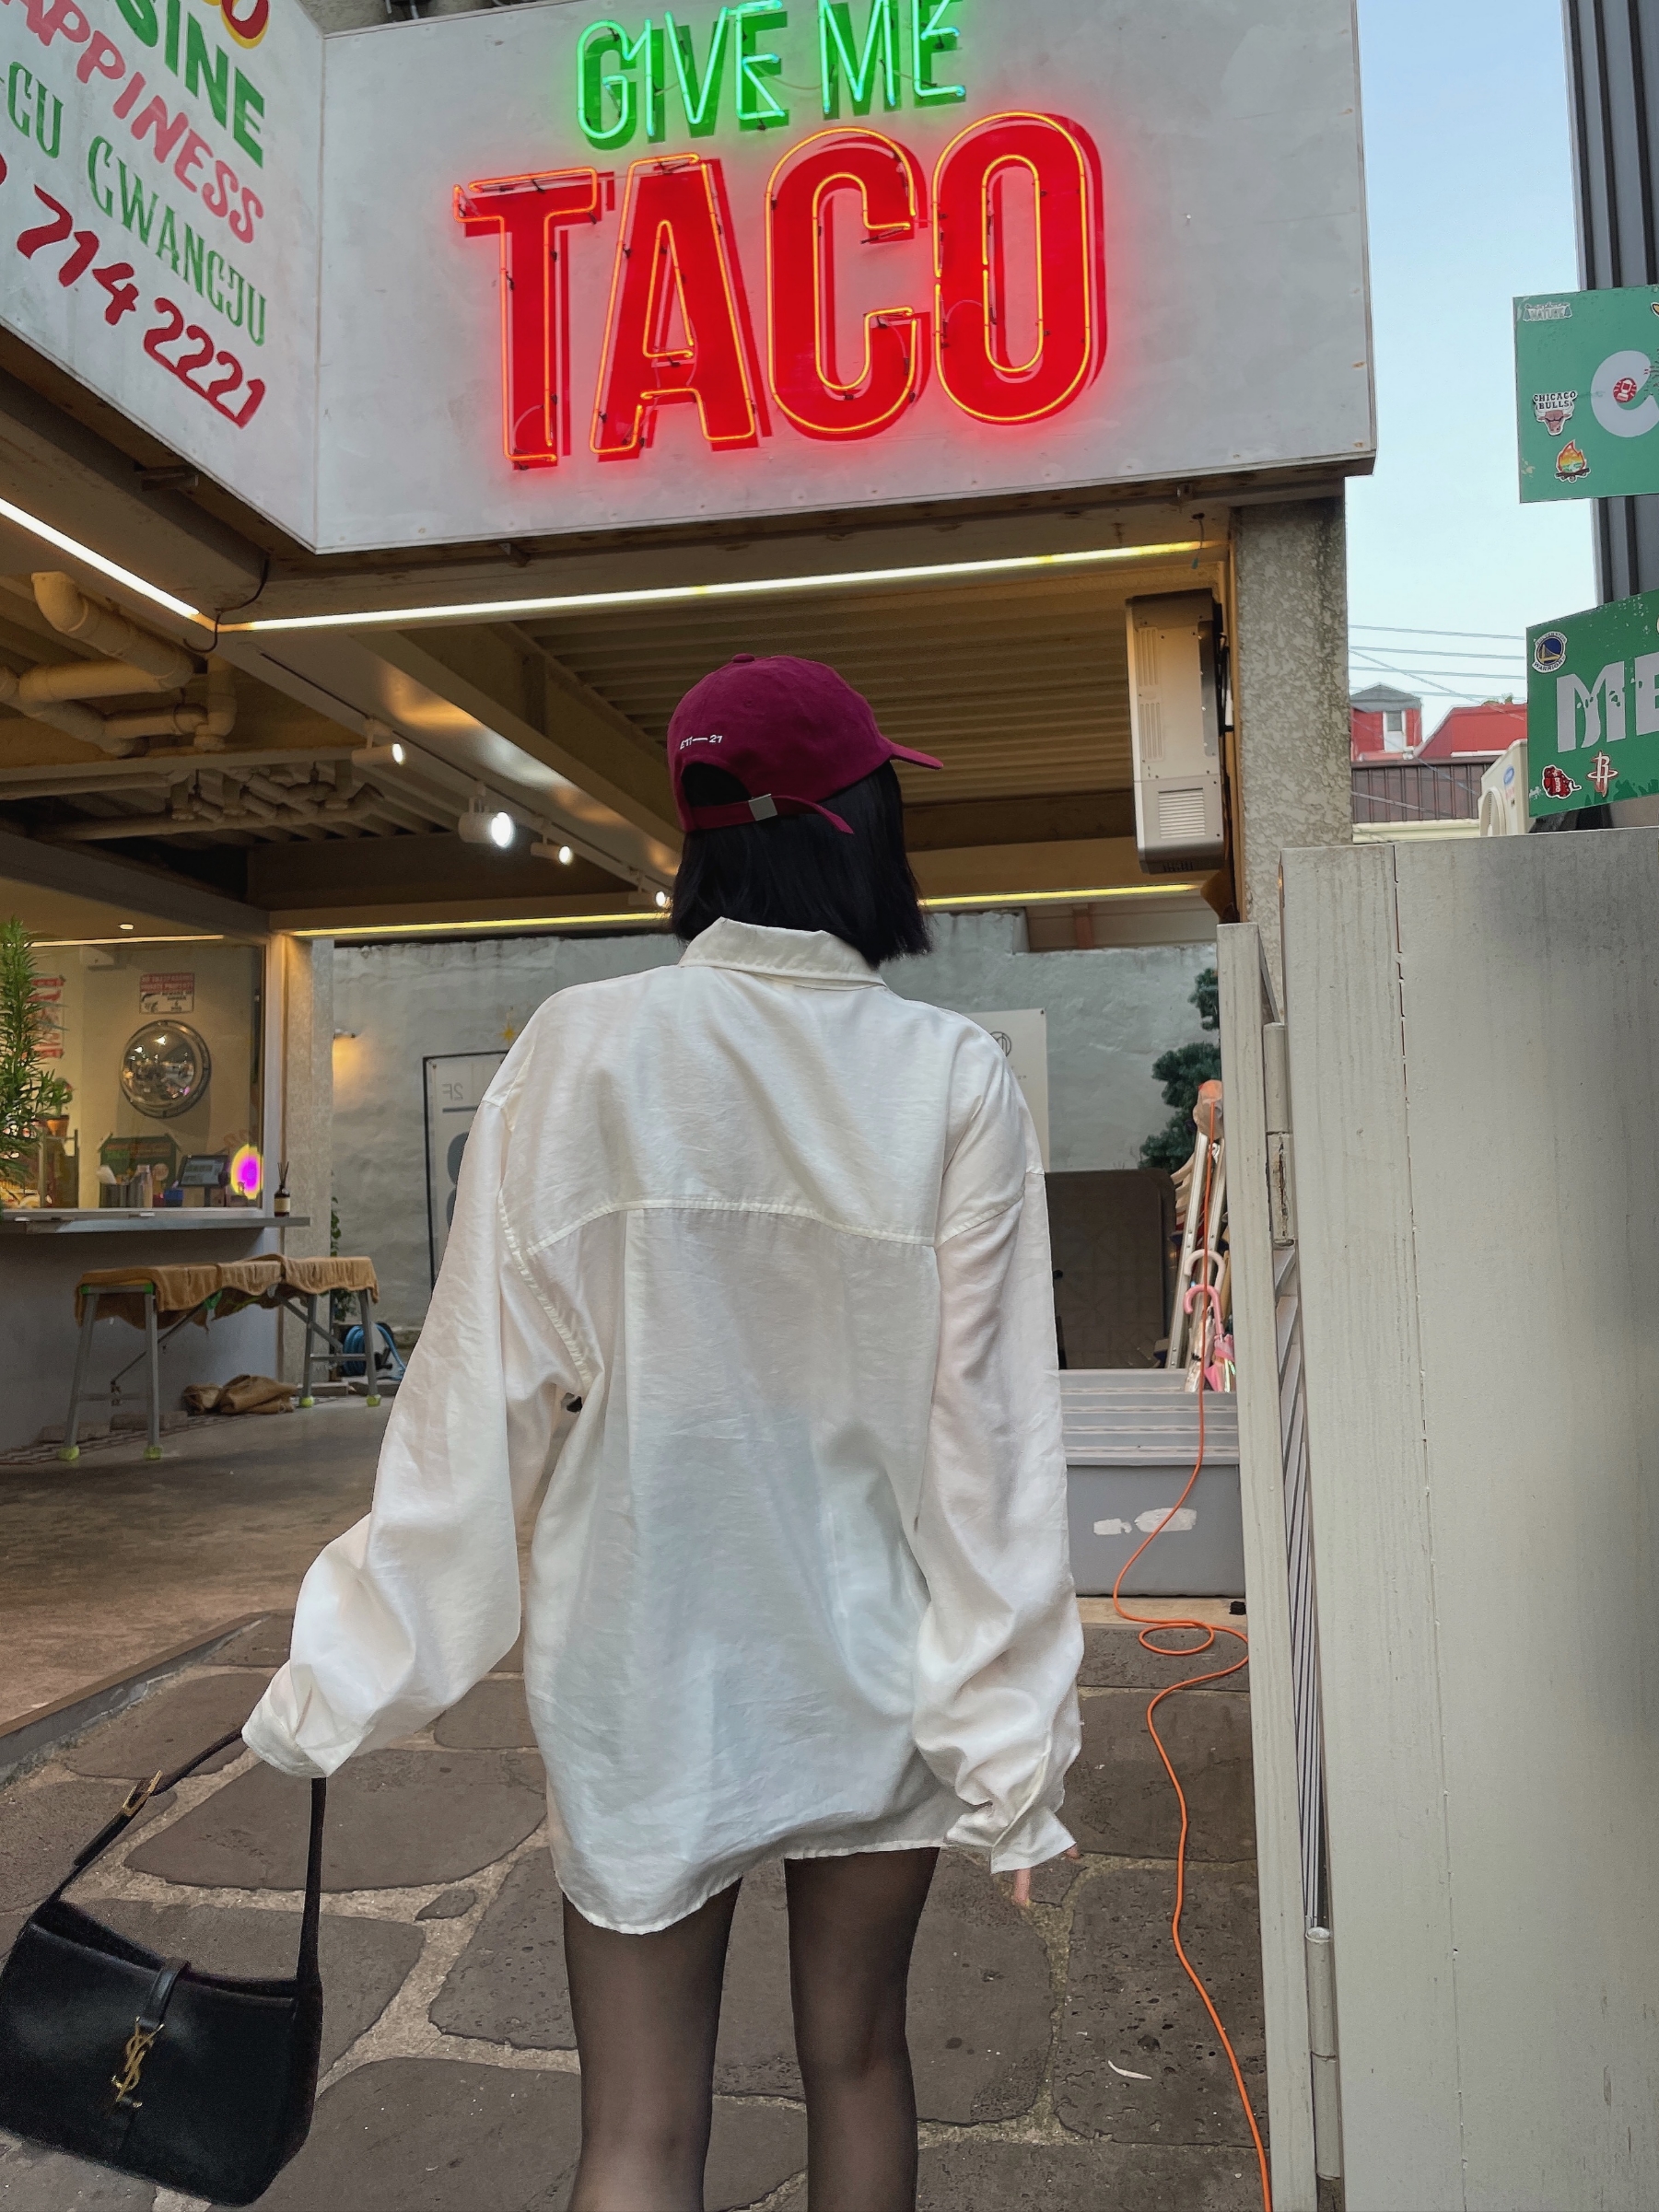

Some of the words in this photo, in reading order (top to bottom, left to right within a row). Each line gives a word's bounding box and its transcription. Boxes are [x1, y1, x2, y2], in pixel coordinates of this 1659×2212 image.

[577, 0, 790, 150] GIVE
[818, 0, 967, 121] ME
[17, 183, 139, 325] 714
[143, 297, 266, 430] 2221
[453, 110, 1107, 472] TACO
[1533, 390, 1576, 402] CHICAGO
[1537, 400, 1570, 410] BULLS
